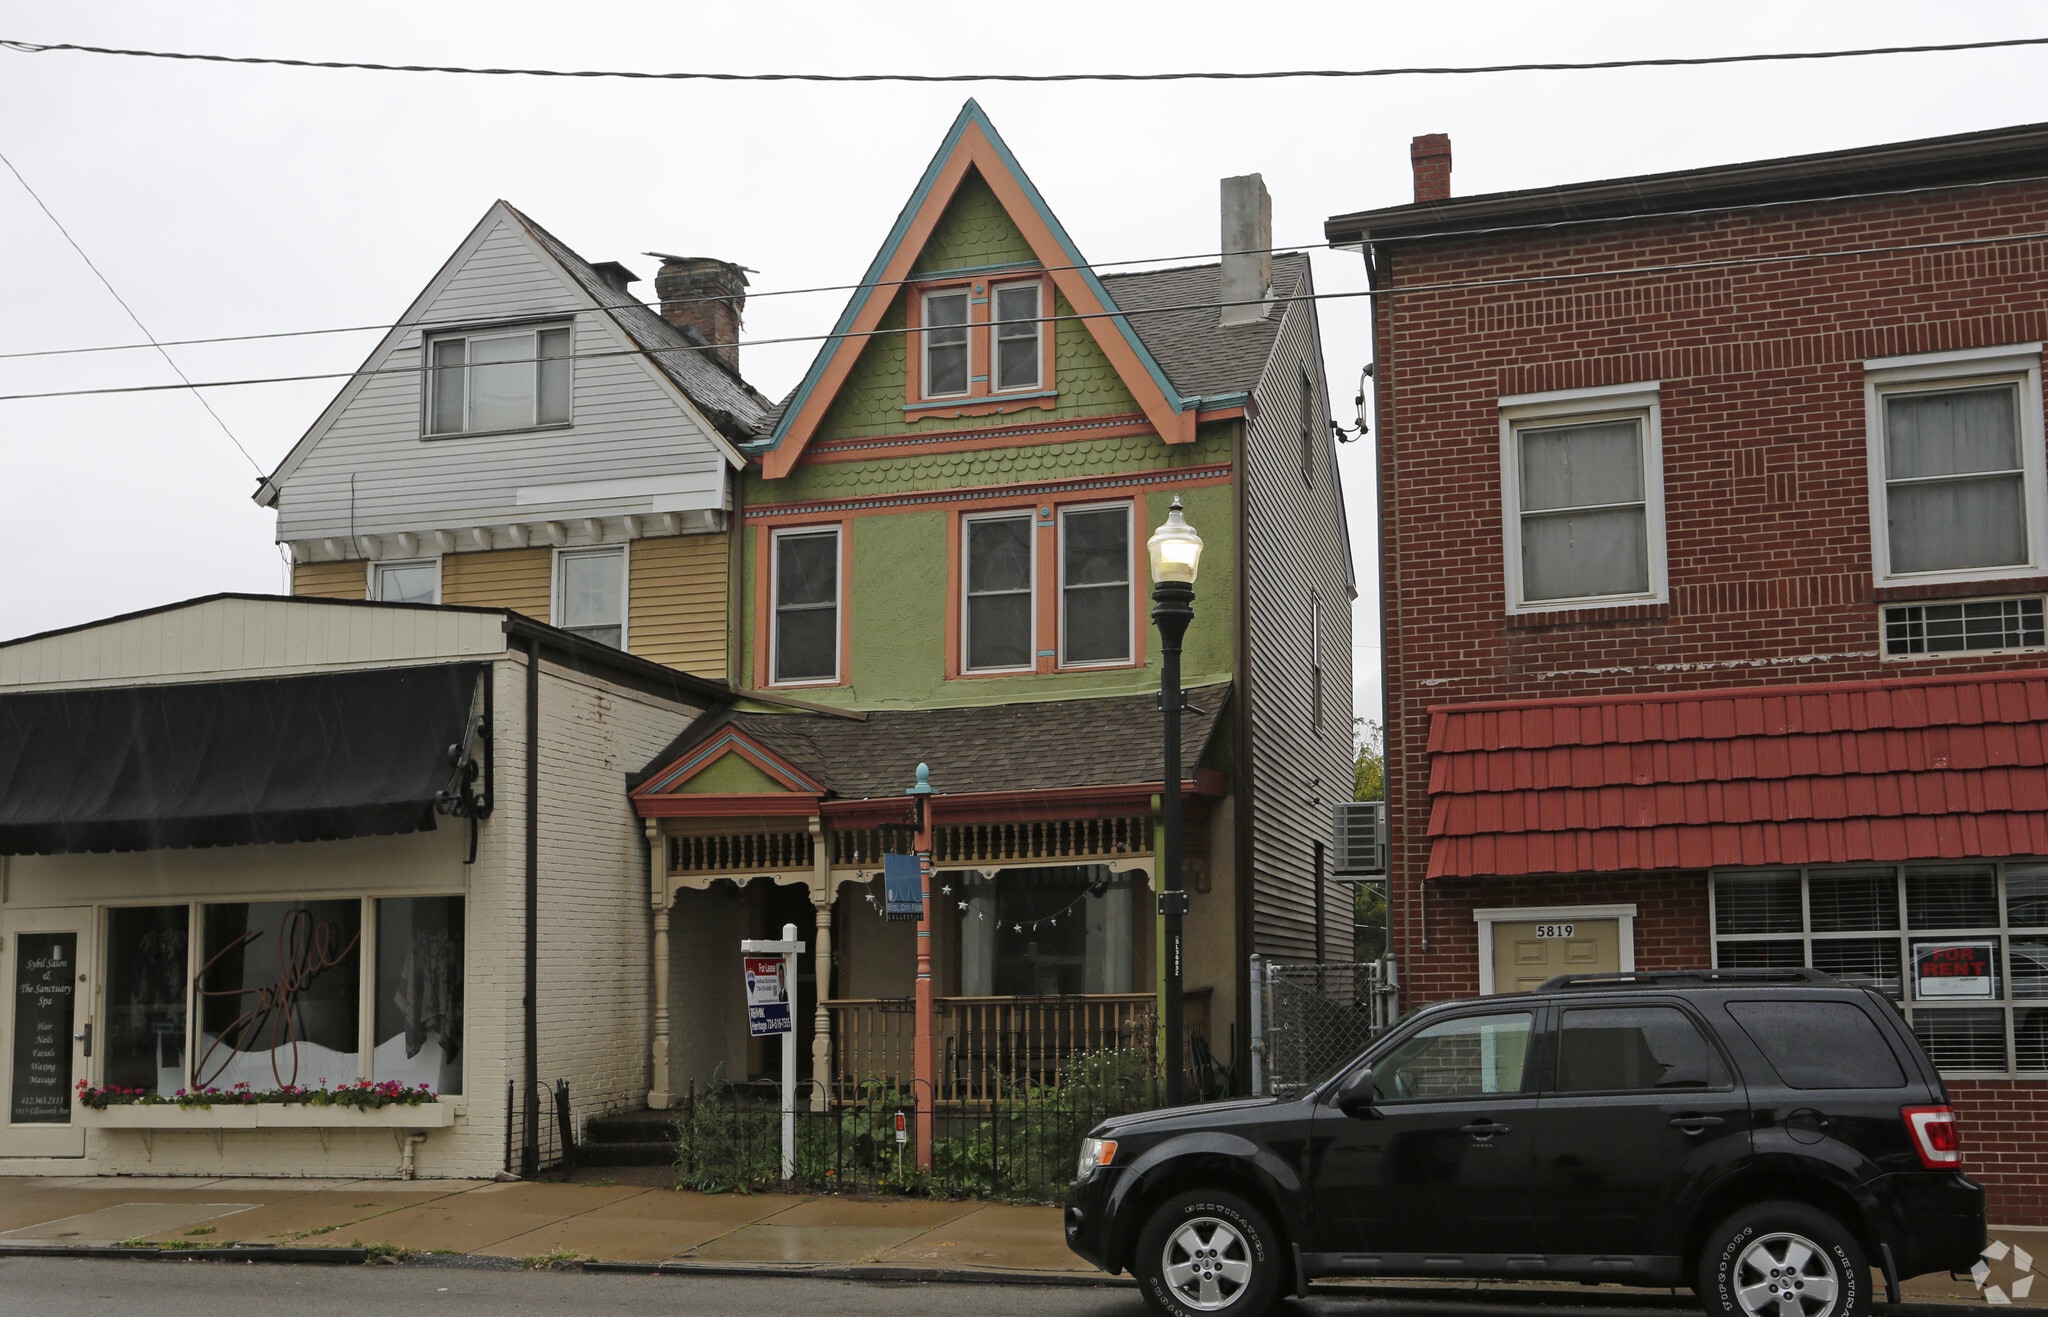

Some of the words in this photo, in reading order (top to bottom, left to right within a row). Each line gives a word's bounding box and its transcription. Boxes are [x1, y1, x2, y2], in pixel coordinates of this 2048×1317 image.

[1537, 925, 1573, 937] 5819
[1933, 948, 1974, 960] FOR
[26, 958, 45, 971] Sybil
[47, 959, 67, 968] Salon
[758, 963, 767, 973] For
[766, 963, 776, 973] Lease
[1923, 962, 1985, 976] RENT
[42, 970, 52, 980] &
[21, 984, 33, 993] The
[34, 985, 72, 995] Sanctuary
[38, 997, 52, 1008] Spa
[37, 1022, 53, 1030] Hair
[35, 1035, 53, 1044] Nails
[32, 1048, 55, 1057] Facials
[30, 1062, 56, 1072] Waxing
[28, 1076, 57, 1086] Massage
[1185, 1204, 1264, 1261] DESTINATION
